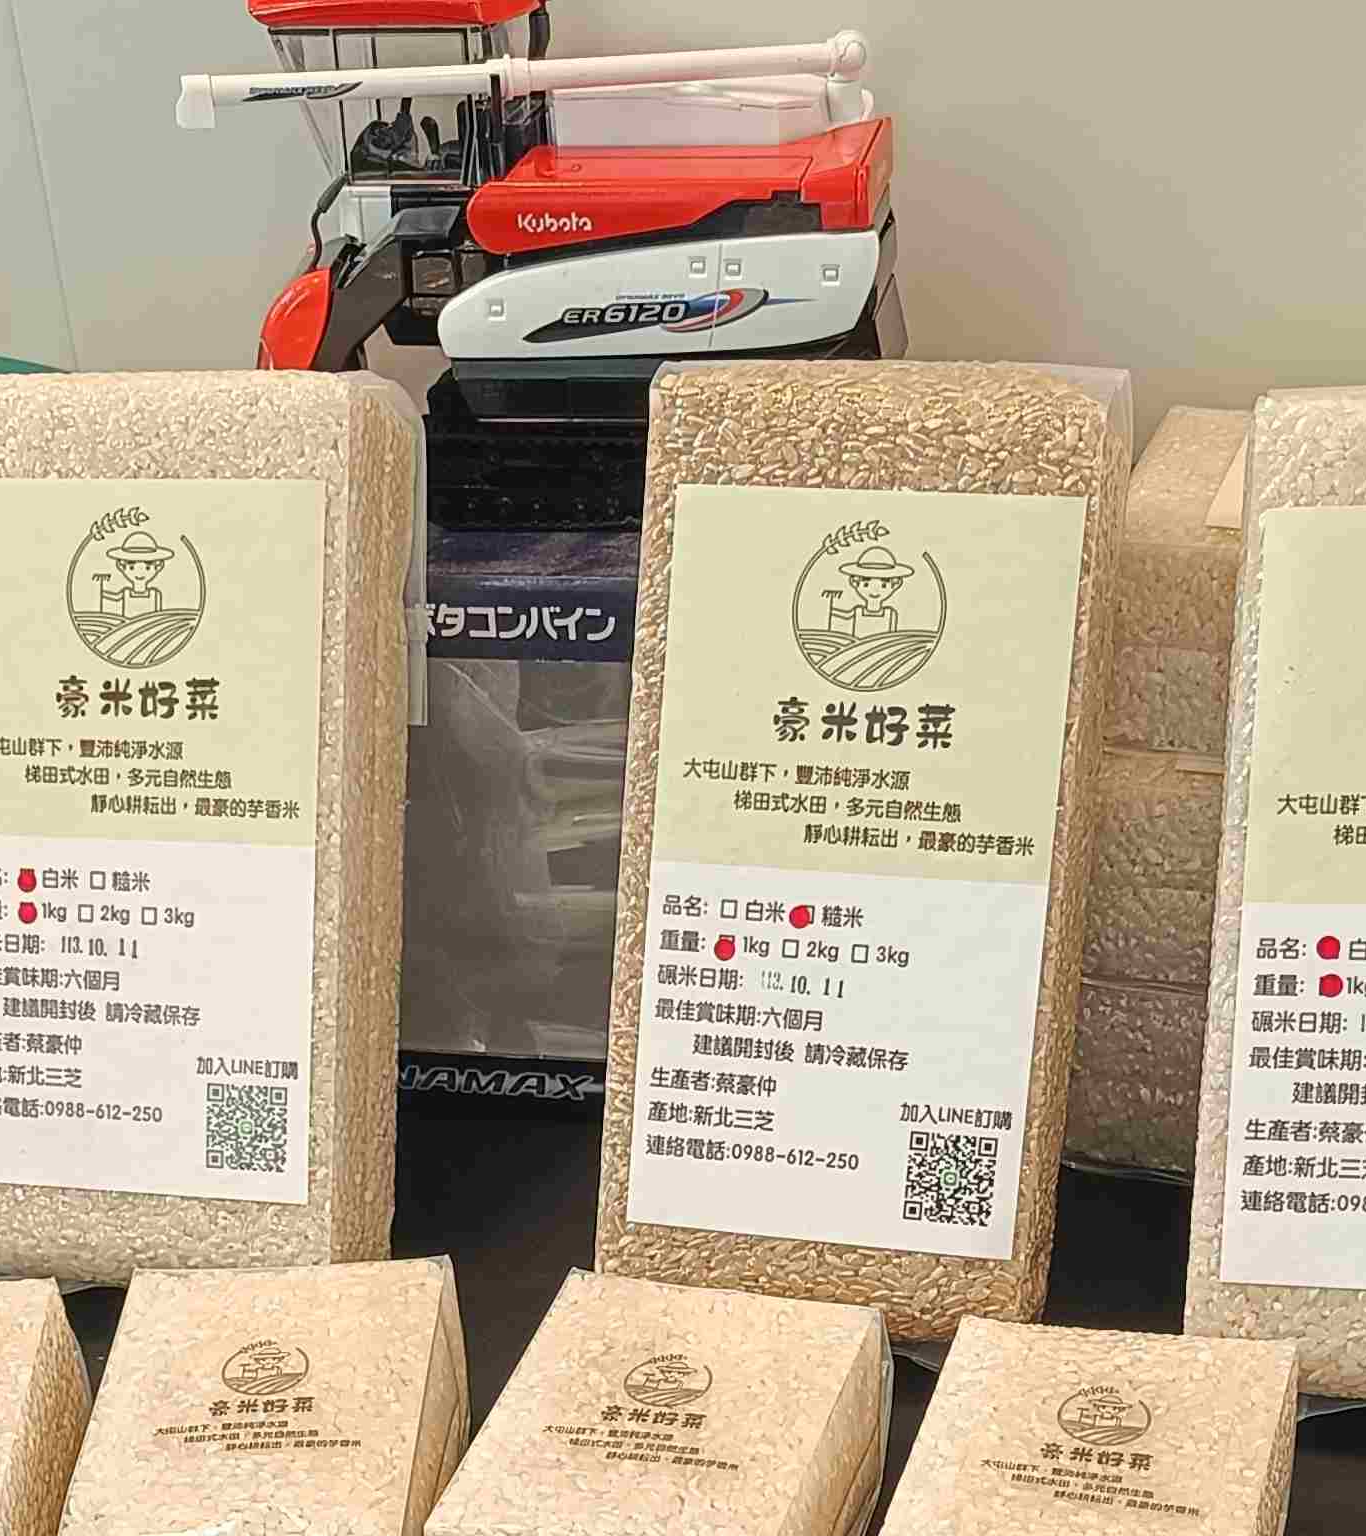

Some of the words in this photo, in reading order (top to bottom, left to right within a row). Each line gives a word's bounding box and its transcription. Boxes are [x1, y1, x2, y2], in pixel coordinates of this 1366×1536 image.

[518, 212, 592, 233] Kubota
[563, 302, 686, 325] ER6120
[56, 675, 220, 721] 豪米好菜
[773, 697, 956, 750] 豪米好菜
[42, 869, 79, 891] 白米
[112, 870, 151, 893] 糙米
[42, 903, 67, 923] 1kg
[100, 905, 131, 926] 2kg
[163, 907, 195, 928] 3kg
[745, 900, 785, 924] 白米
[821, 905, 864, 929] 糙米
[743, 936, 770, 957] 1kg
[806, 940, 839, 963] 2kg
[875, 944, 909, 967] 3kg
[3, 997, 96, 1022] 建議開封後
[105, 1002, 201, 1027] 請冷藏保存
[693, 1033, 794, 1062] 建議開封後
[804, 1041, 910, 1072] 請冷藏保存
[196, 1056, 299, 1080] 加入LINE訂購
[899, 1102, 1013, 1132] 加入LINE訂購
